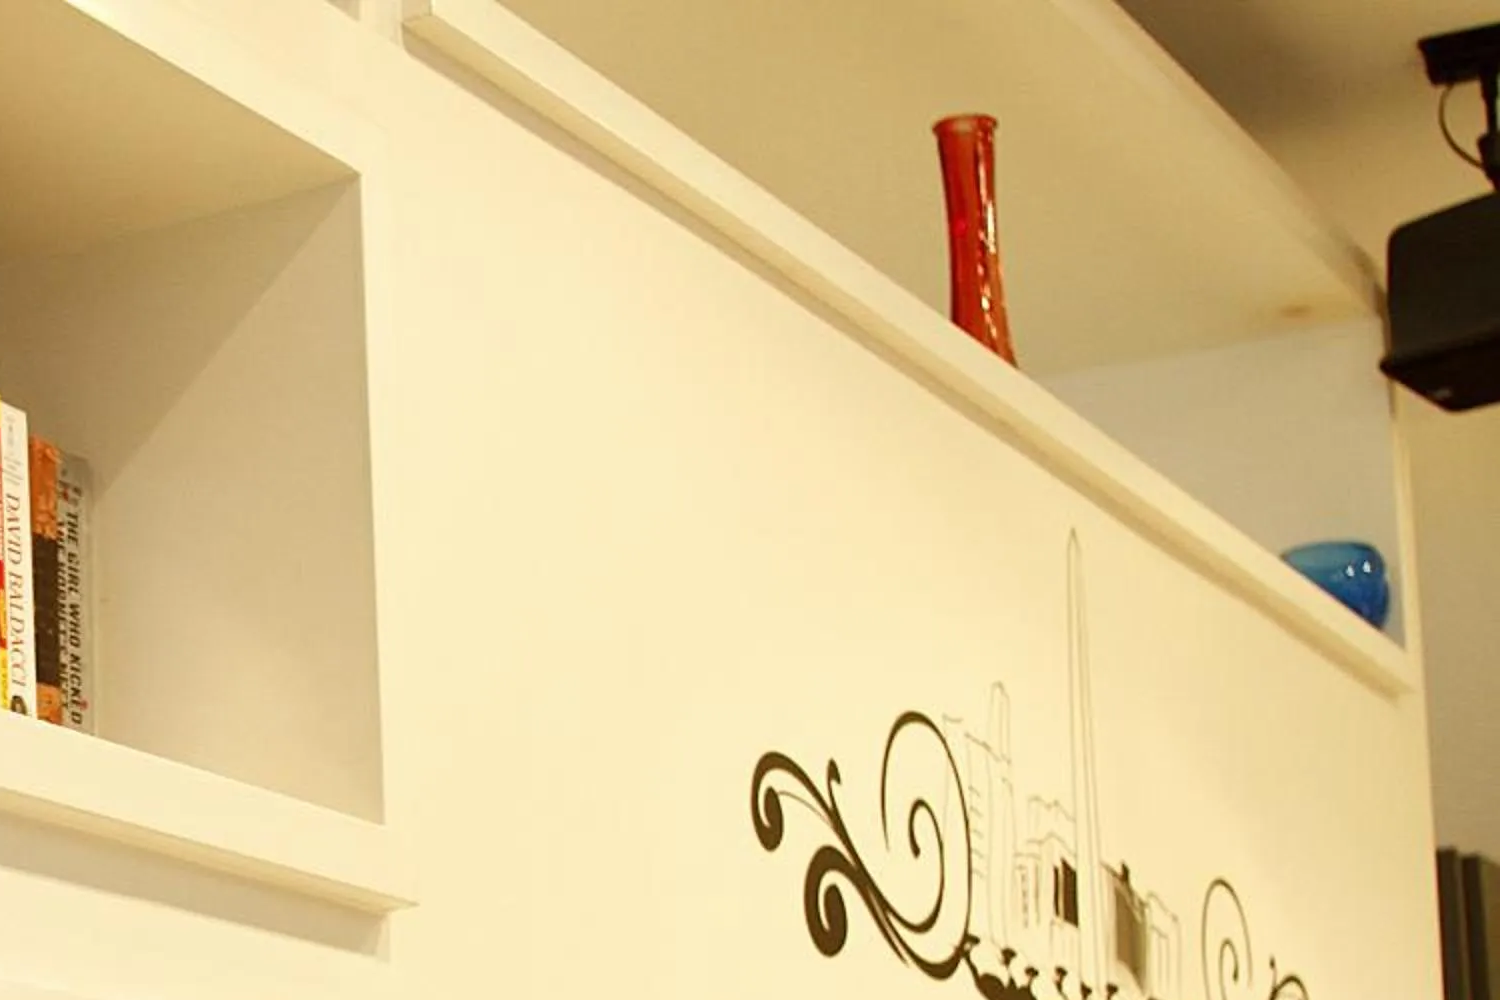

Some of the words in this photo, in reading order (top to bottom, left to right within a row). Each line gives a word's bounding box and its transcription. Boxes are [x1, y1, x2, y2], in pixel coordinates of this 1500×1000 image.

[5, 492, 23, 566] DAVID
[65, 511, 80, 546] THE
[67, 551, 81, 596] GIRL
[7, 569, 27, 689] BALDACCI
[67, 601, 83, 649] WHO
[69, 652, 85, 726] KICKED
